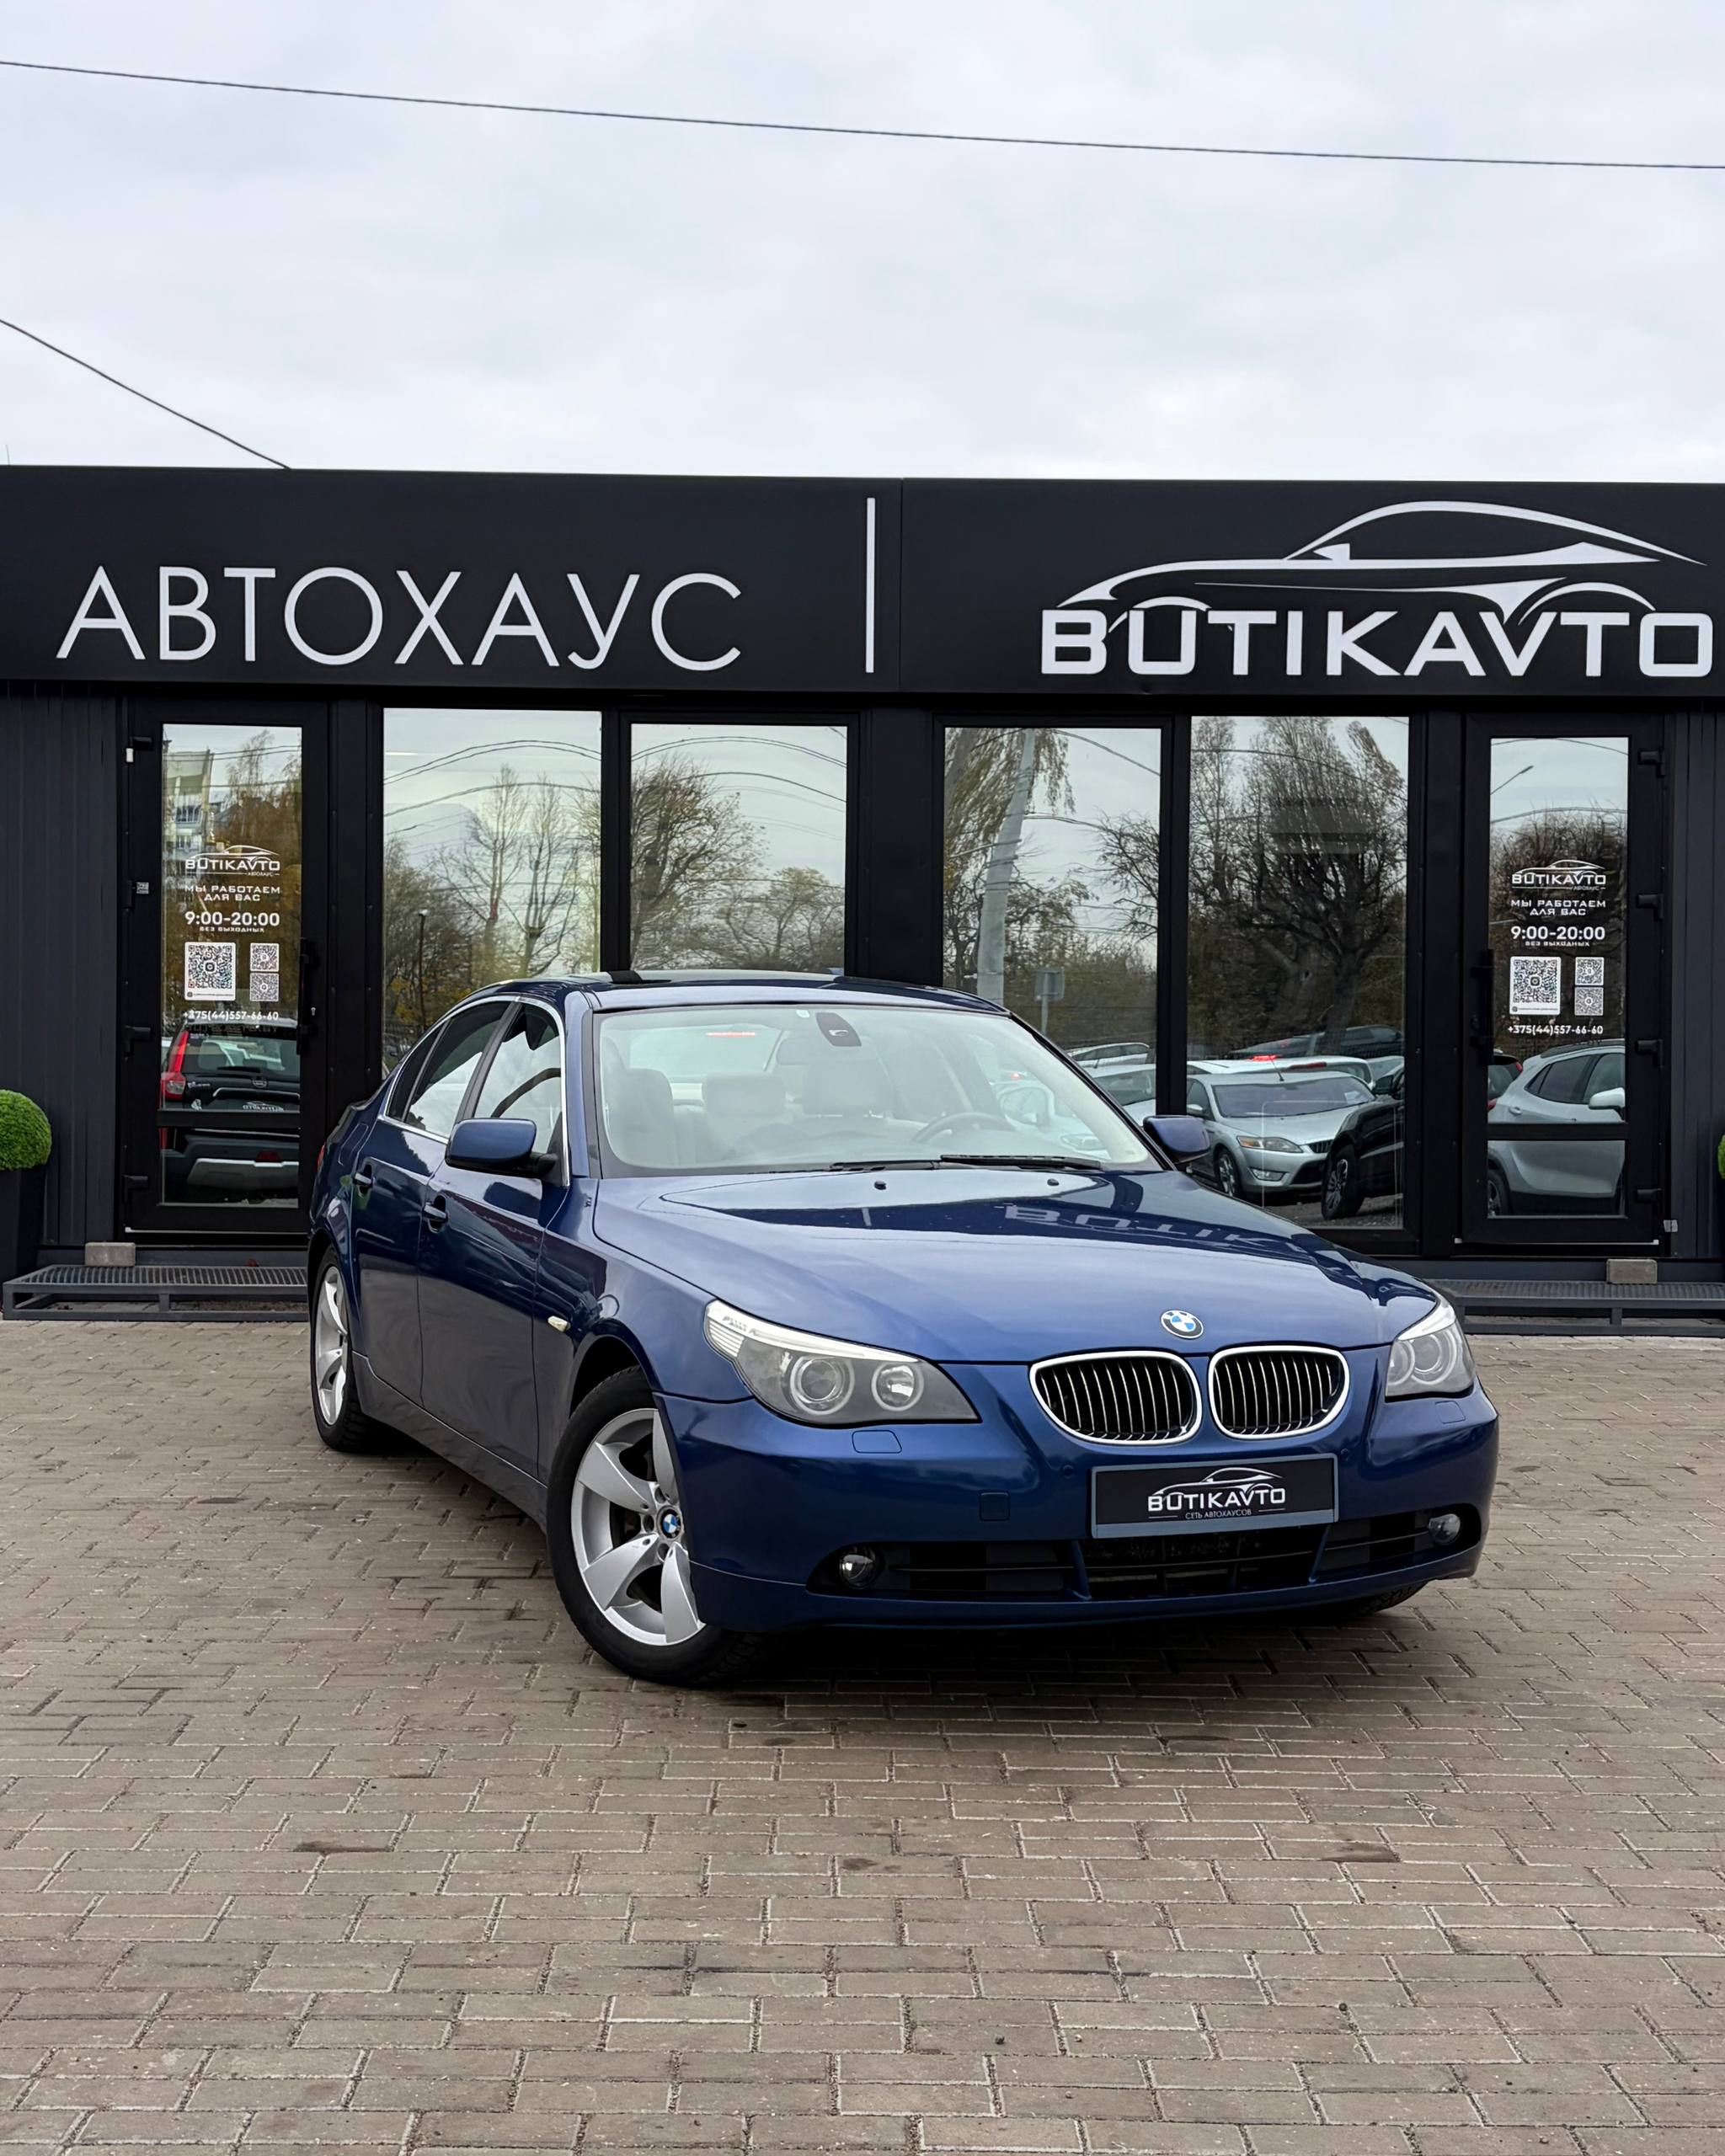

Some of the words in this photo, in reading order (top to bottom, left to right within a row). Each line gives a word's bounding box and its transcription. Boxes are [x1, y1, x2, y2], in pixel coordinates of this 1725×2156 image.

[56, 565, 741, 671] АВТОХАУС
[1042, 609, 1713, 677] BUTIKAVTO
[185, 858, 280, 871] BUTIKAVTO
[1512, 873, 1606, 885] BUTIKAVTO
[211, 885, 280, 894] РАБОТАЕМ
[1537, 899, 1606, 908] РАБОТАЕМ
[1530, 908, 1556, 916] ДЛЯ
[185, 911, 280, 926] 9:00-20:00
[1510, 926, 1605, 940] 9:00-20:00
[1508, 1024, 1604, 1036] +375(44)557-66-60
[1148, 1488, 1286, 1512] BUTIKAVTO
[1185, 1512, 1203, 1520] СЕТЬ
[1204, 1508, 1252, 1518] АВТОХАУСОВ
